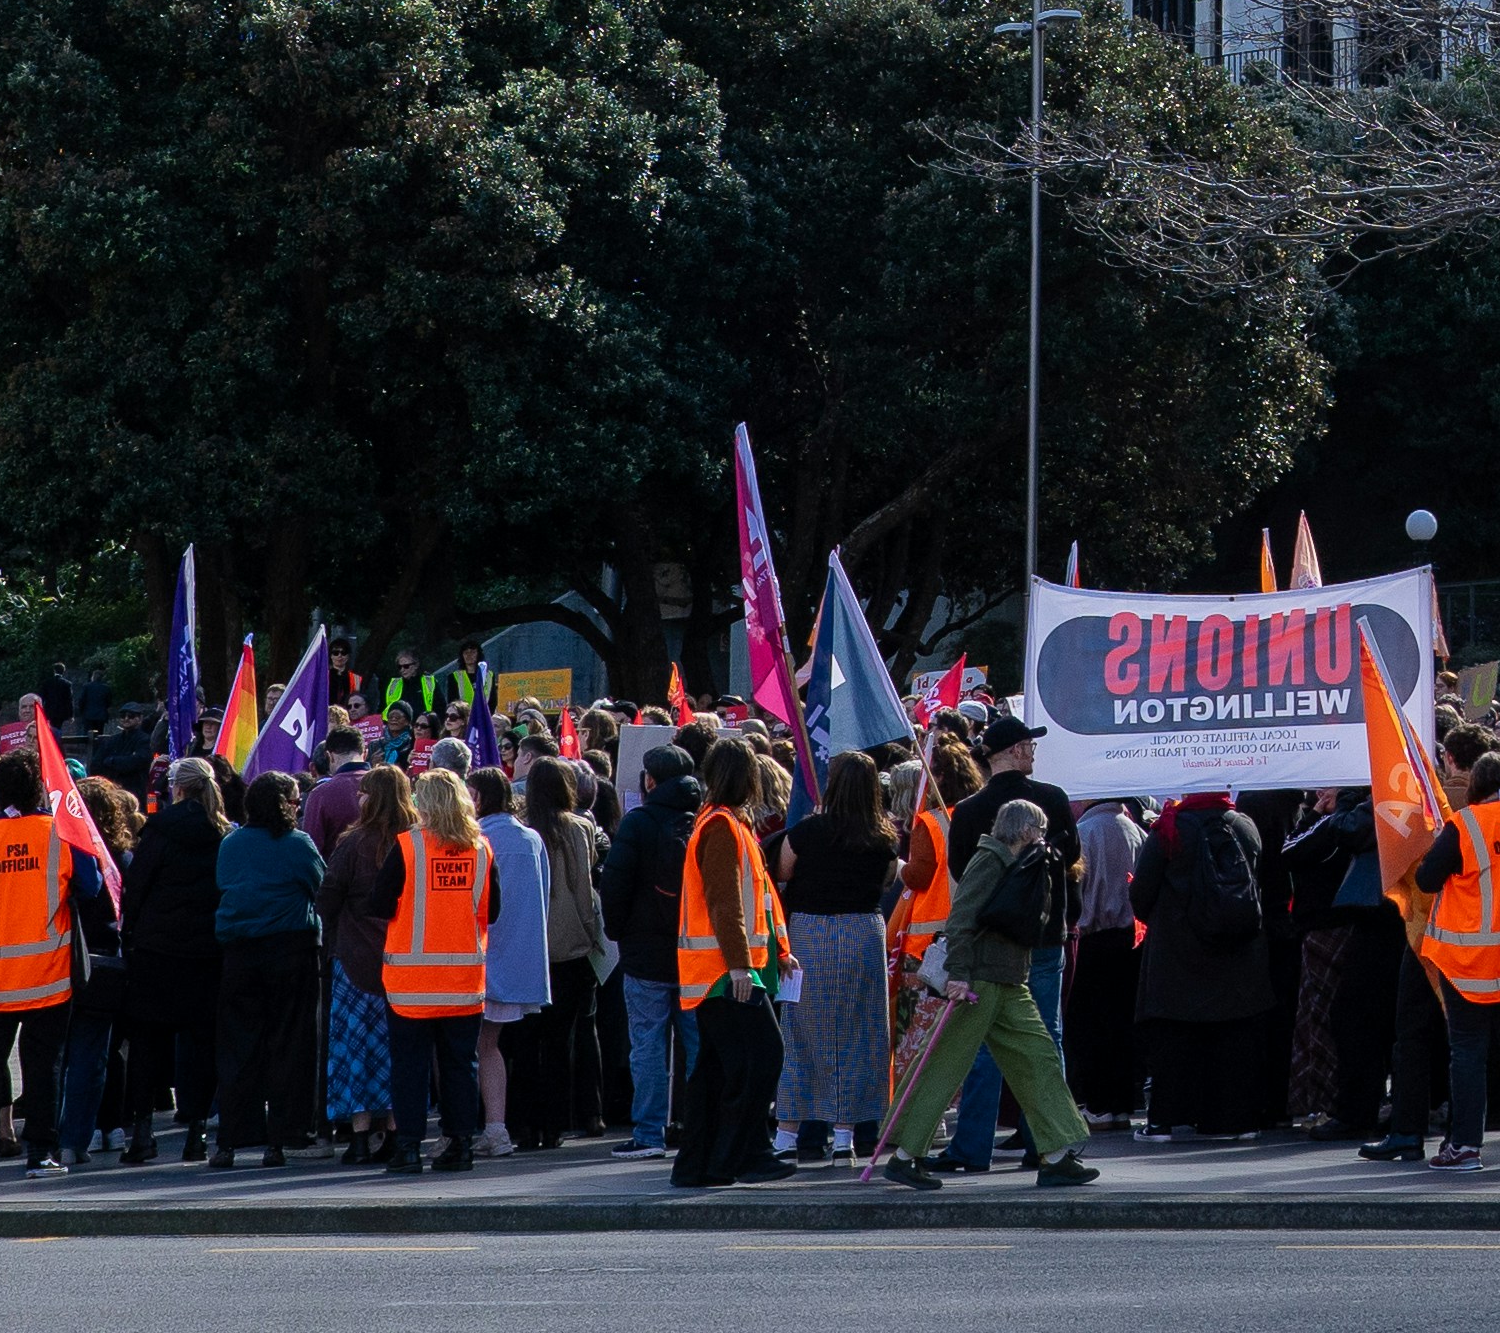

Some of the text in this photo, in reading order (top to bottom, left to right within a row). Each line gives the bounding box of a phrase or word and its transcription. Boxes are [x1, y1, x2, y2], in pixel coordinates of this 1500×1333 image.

[7, 843, 29, 857] PSA
[435, 862, 470, 874] EVENT
[437, 876, 467, 887] TEAM
